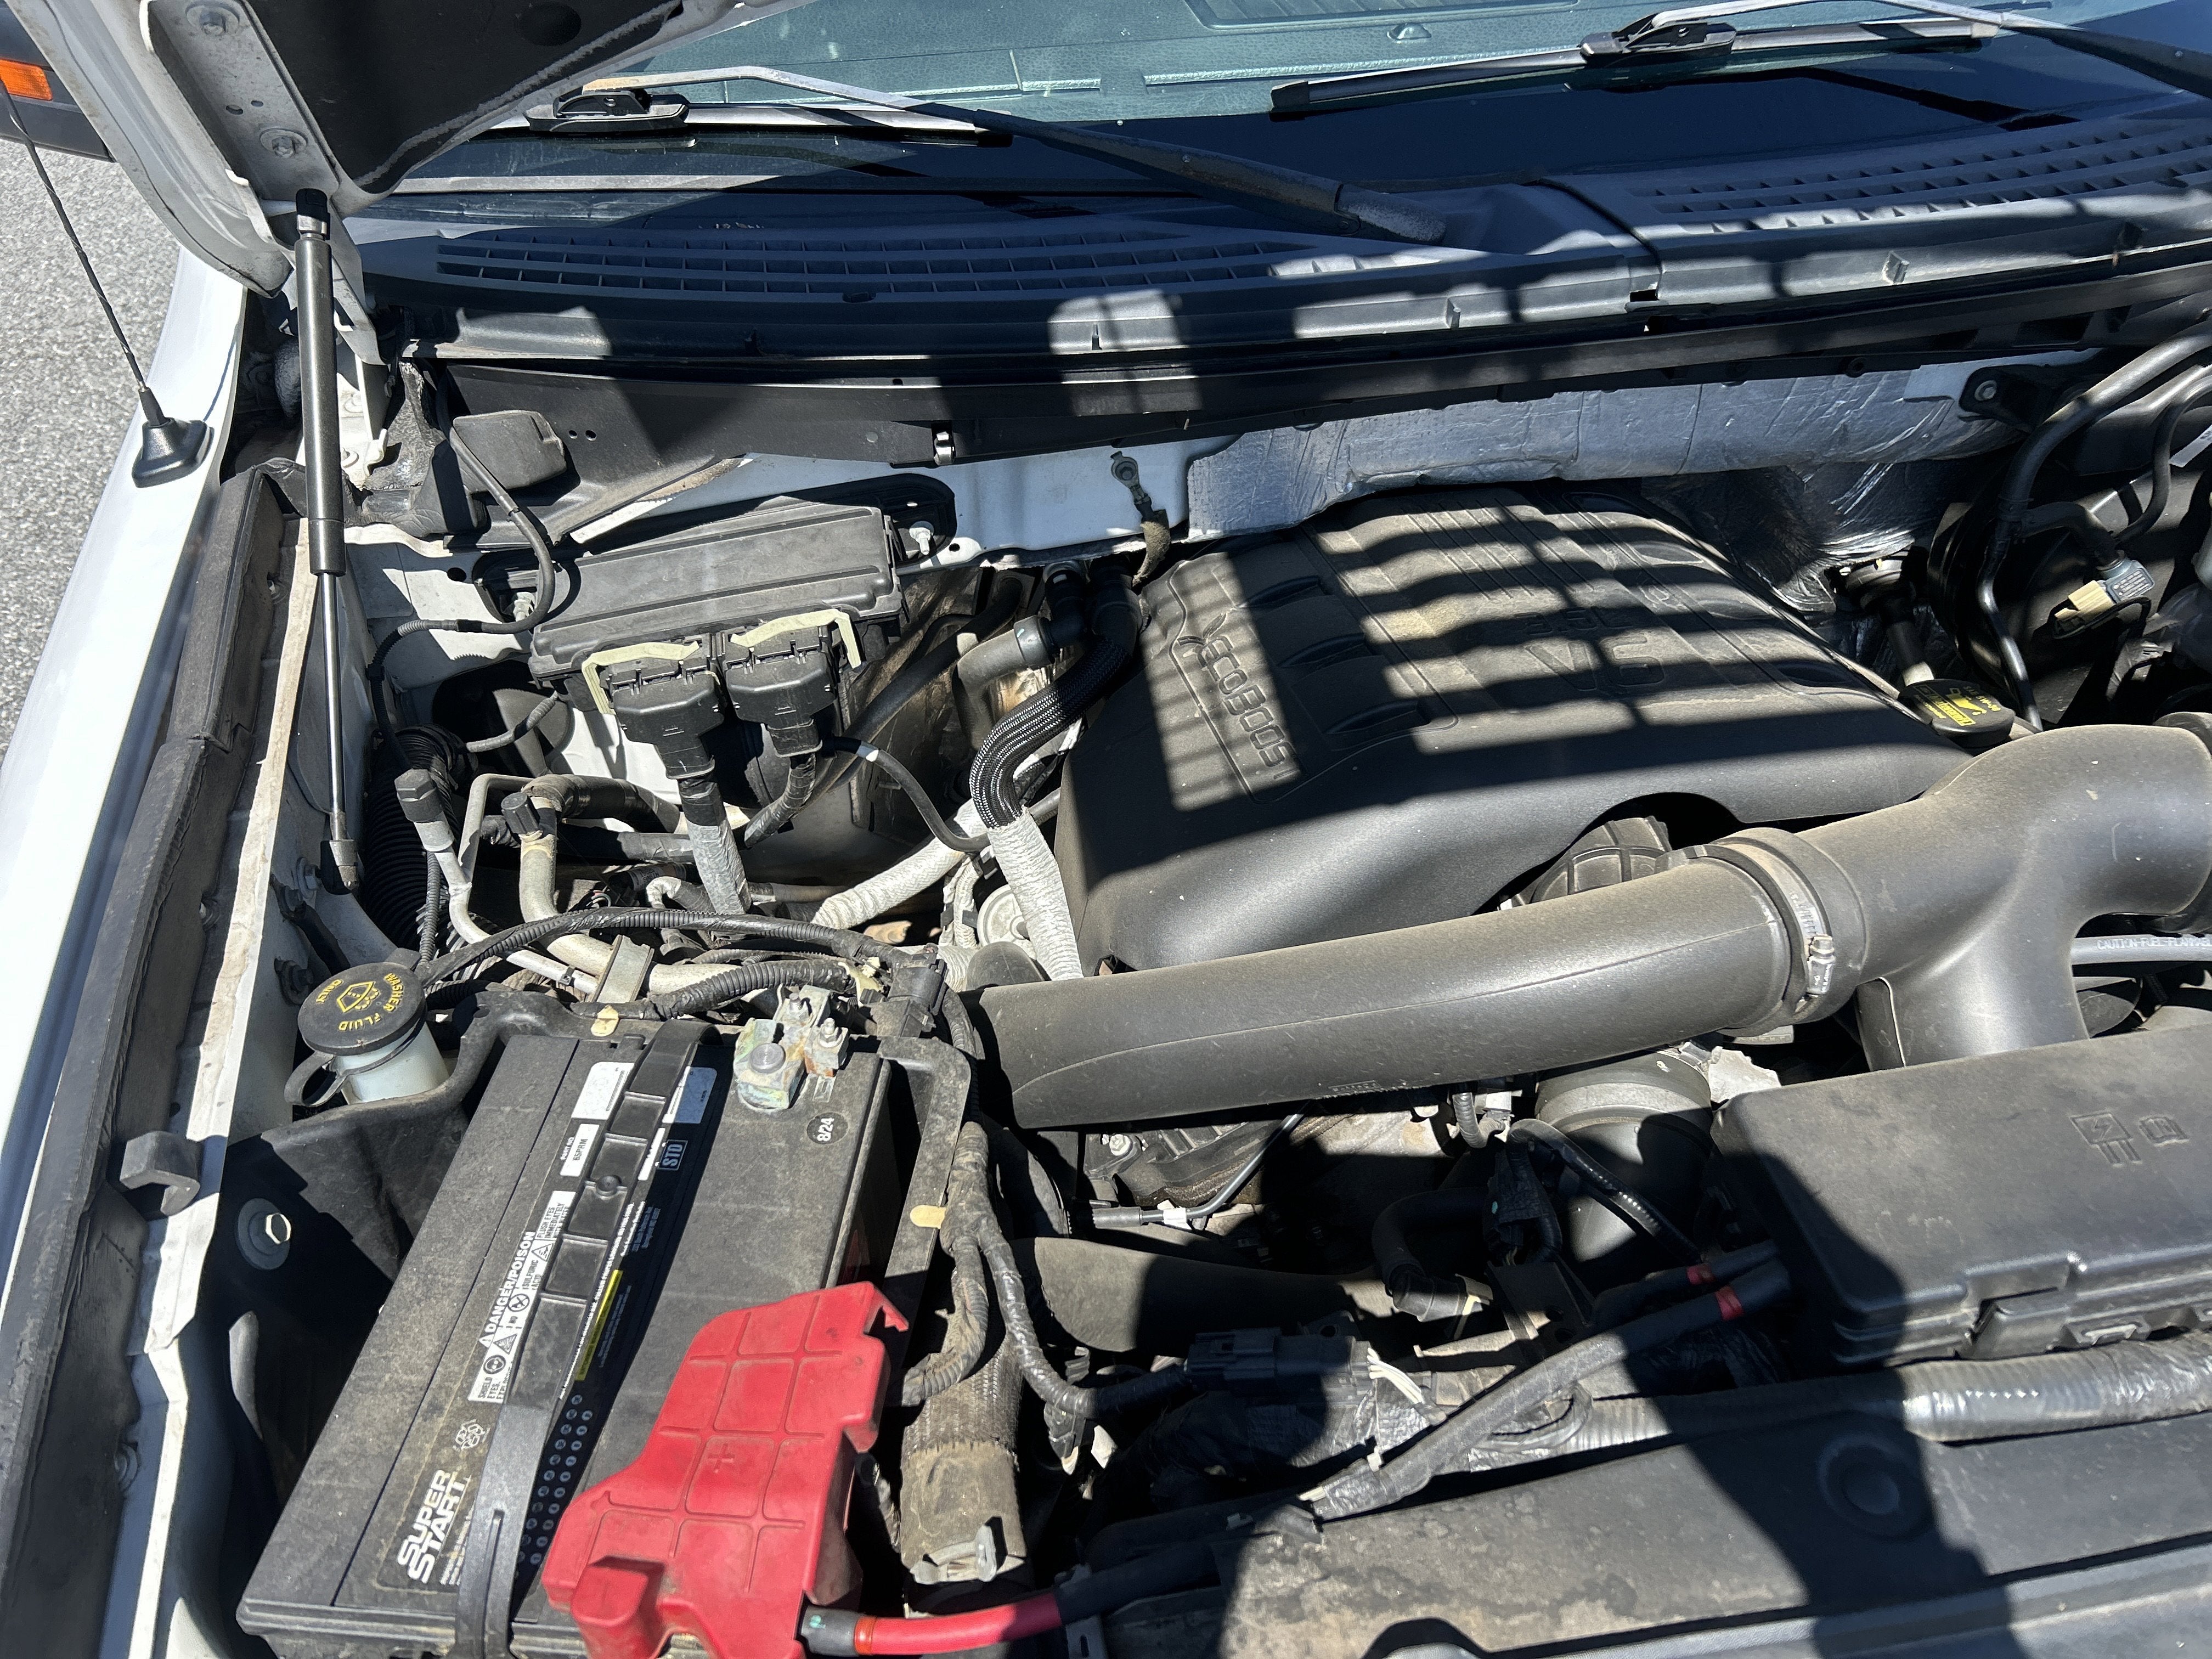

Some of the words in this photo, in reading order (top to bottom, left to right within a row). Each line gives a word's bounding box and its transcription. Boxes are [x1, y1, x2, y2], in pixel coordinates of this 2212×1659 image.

[1523, 634, 1666, 691] V6
[316, 979, 343, 1004] ONLY
[383, 973, 404, 1012] WASHER
[338, 1013, 382, 1031] FLUID
[817, 1118, 834, 1141] 8/24
[572, 1139, 588, 1160] 65PRM
[662, 1143, 683, 1167] STD
[537, 1222, 549, 1238] FLUSH
[544, 1207, 555, 1220] EYES
[544, 1203, 565, 1238] IMMEDIATELY
[485, 1231, 535, 1333] DANGER/POISON
[522, 1260, 539, 1287] SULFURIC
[477, 1377, 493, 1398] SHIELD
[397, 1469, 451, 1566] SUPER
[407, 1471, 465, 1584] START
